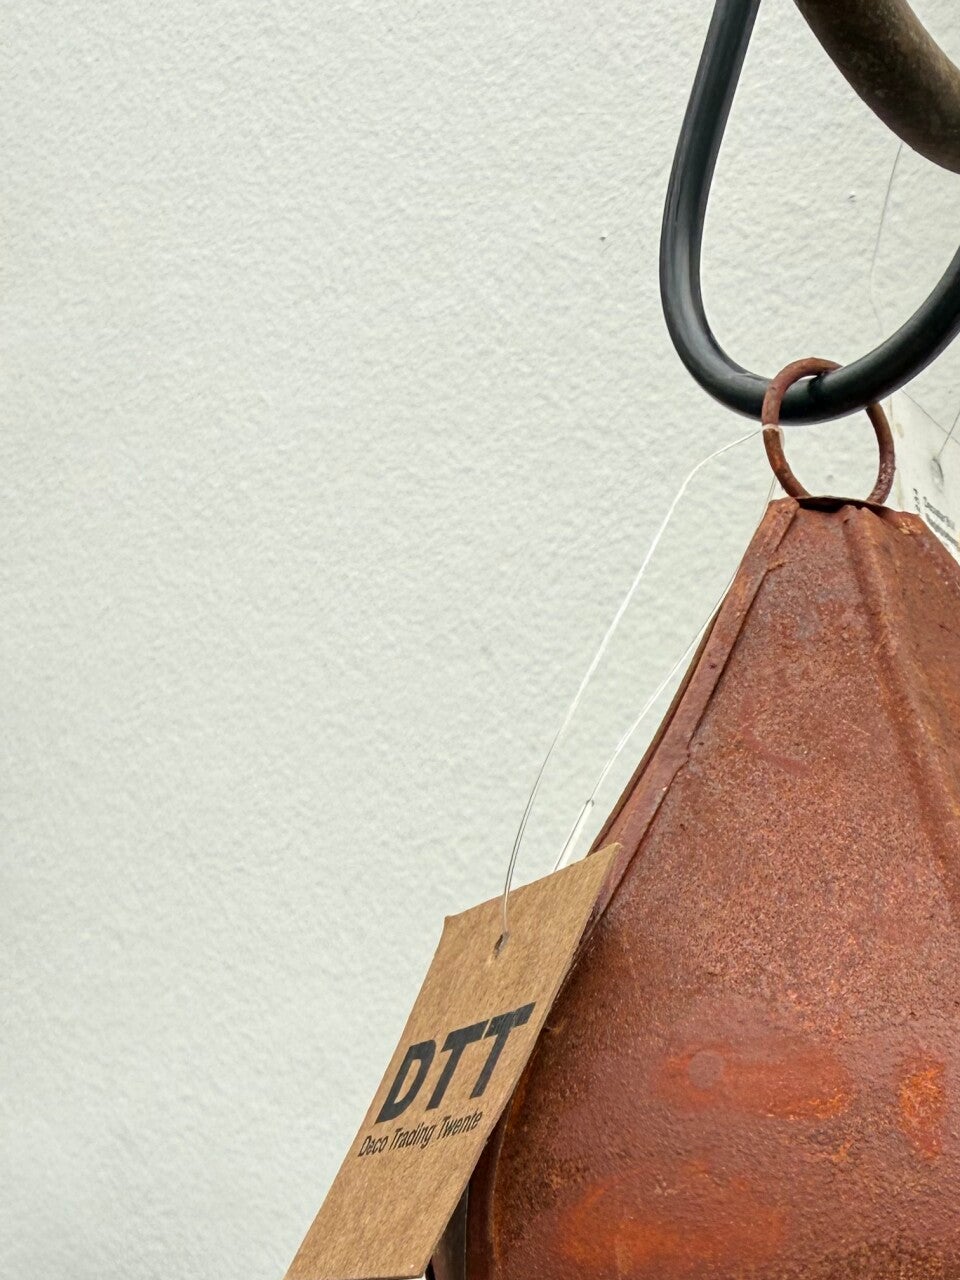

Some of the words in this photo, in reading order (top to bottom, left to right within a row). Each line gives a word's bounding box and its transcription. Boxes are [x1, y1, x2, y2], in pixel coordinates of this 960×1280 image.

[375, 1002, 537, 1124] DTT
[358, 1135, 389, 1157] Deco
[389, 1121, 438, 1149] Trading
[437, 1108, 483, 1140] Twente
